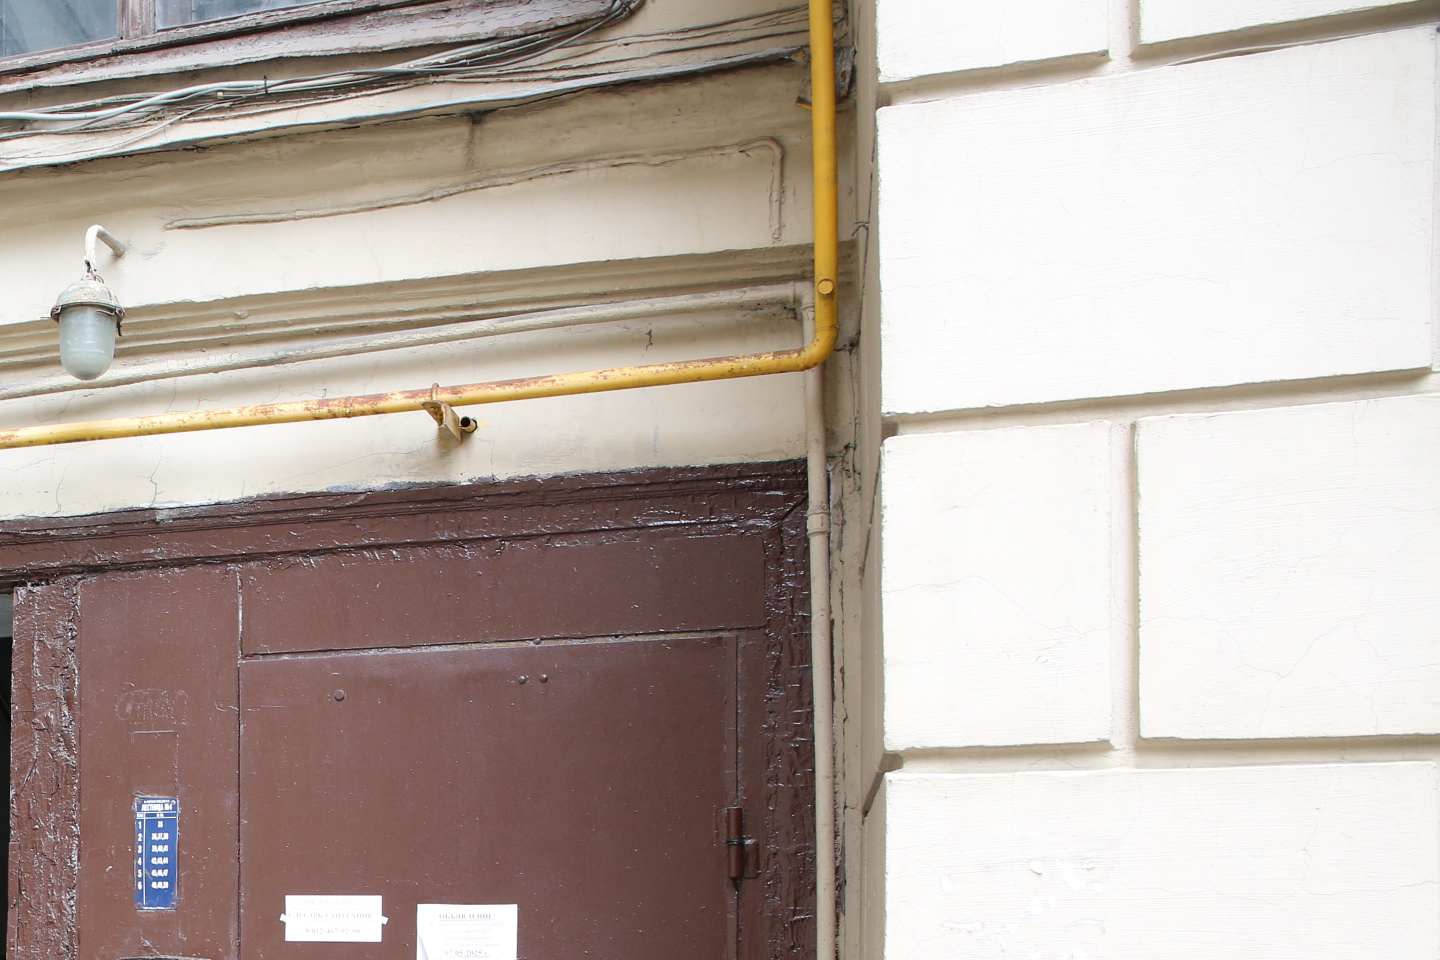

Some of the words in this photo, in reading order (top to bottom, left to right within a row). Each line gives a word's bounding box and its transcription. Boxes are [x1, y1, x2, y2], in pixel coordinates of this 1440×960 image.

[137, 821, 142, 829] 1
[137, 833, 142, 841] 2
[137, 845, 142, 853] 3
[137, 857, 142, 865] 4
[137, 869, 142, 878] 5
[137, 881, 142, 890] 6
